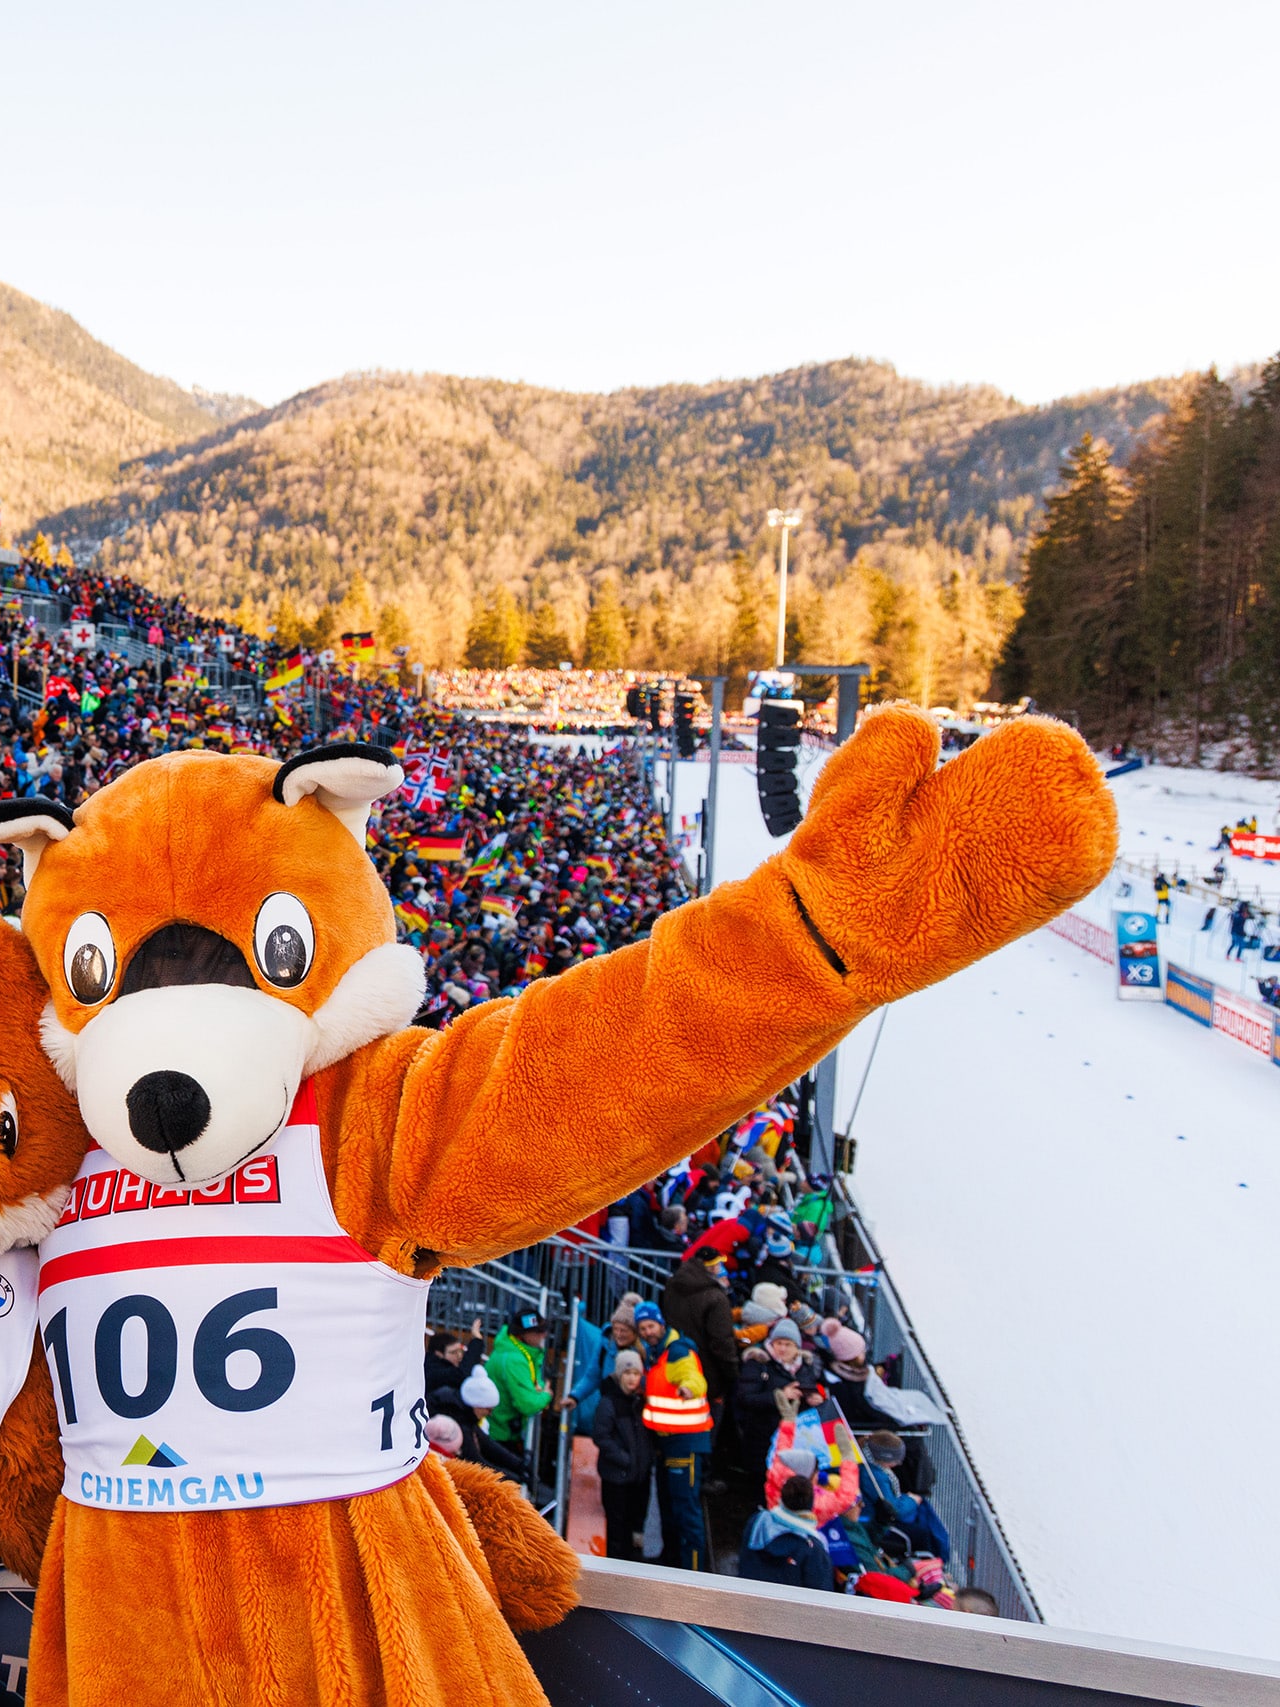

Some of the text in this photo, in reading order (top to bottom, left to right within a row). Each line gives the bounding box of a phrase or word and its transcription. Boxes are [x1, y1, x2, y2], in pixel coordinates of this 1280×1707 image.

[1126, 964, 1154, 982] X3
[43, 1286, 296, 1426] 106
[80, 1471, 265, 1507] CHIEMGAU
